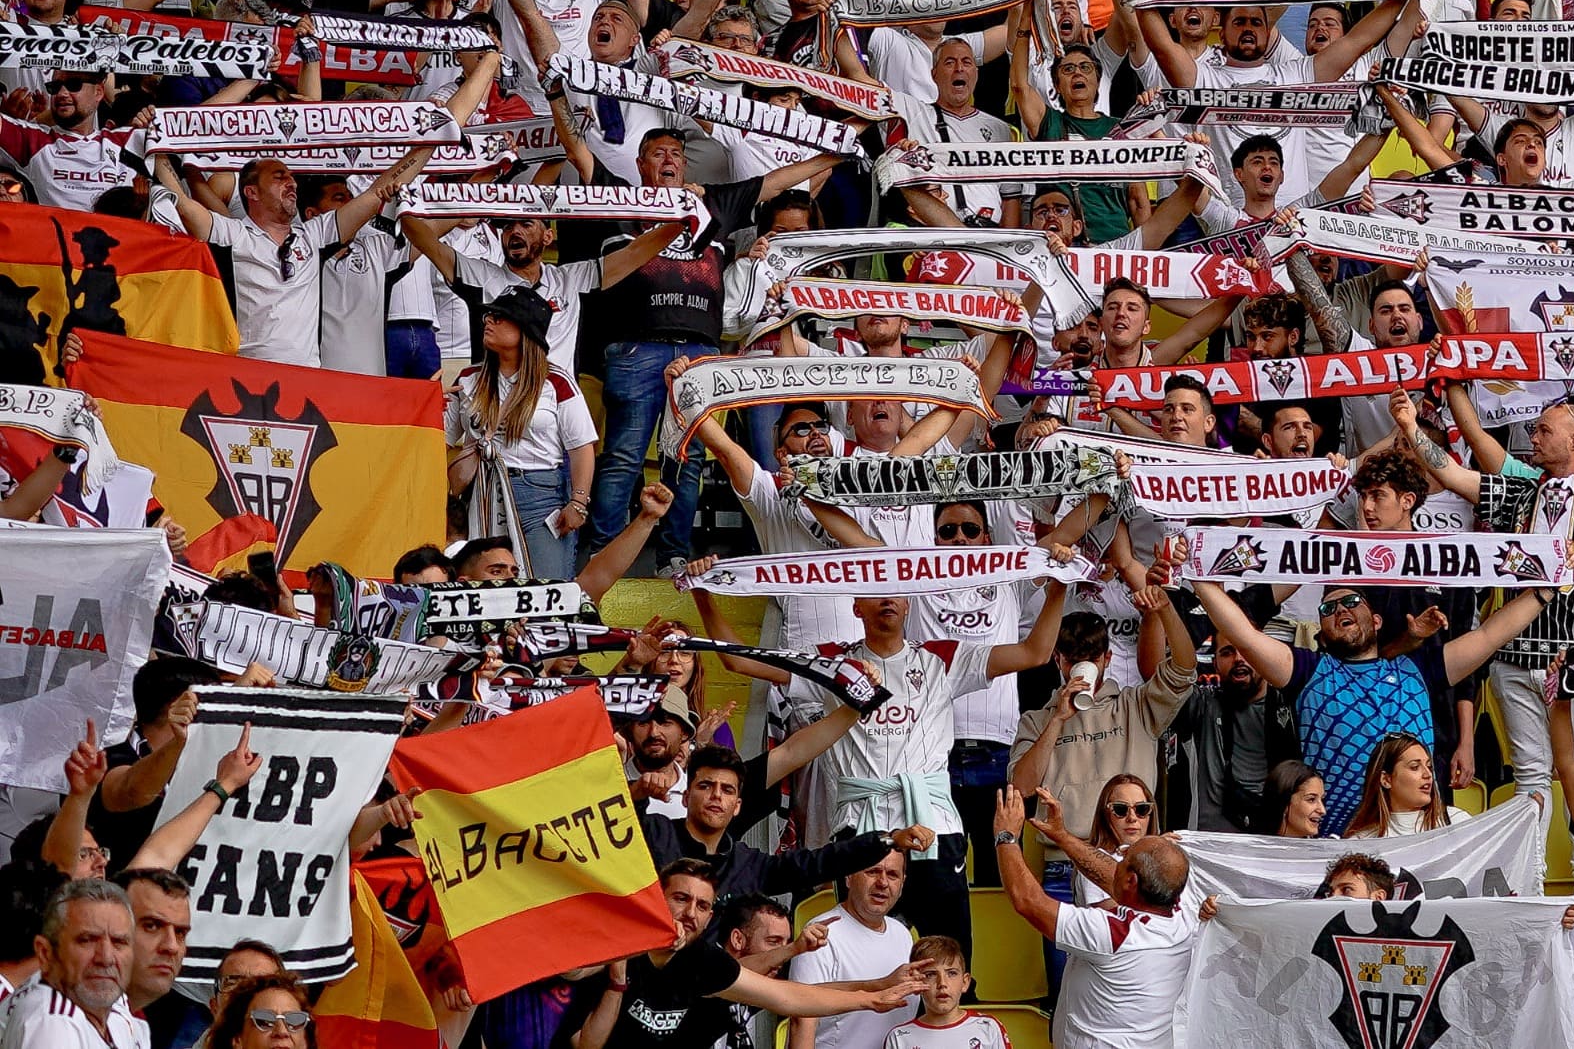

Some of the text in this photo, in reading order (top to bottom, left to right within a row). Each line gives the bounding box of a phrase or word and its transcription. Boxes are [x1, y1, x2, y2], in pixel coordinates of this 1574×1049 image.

[127, 39, 253, 65] Paletos
[1428, 33, 1535, 62] ALBACETE
[715, 52, 800, 82] ALBACETE
[165, 108, 407, 136] MANCHA BLANCA
[948, 146, 1065, 168] ALBACETE
[421, 182, 672, 207] MANCHA BLANCA
[792, 284, 912, 311] ALBACETE
[712, 364, 896, 394] ALBACETE
[1278, 536, 1481, 576] AÚPA ALBA
[755, 561, 890, 584] ALBACETE
[937, 609, 991, 629] iner
[201, 604, 330, 684] YOUTH
[1055, 726, 1124, 748] carhartt
